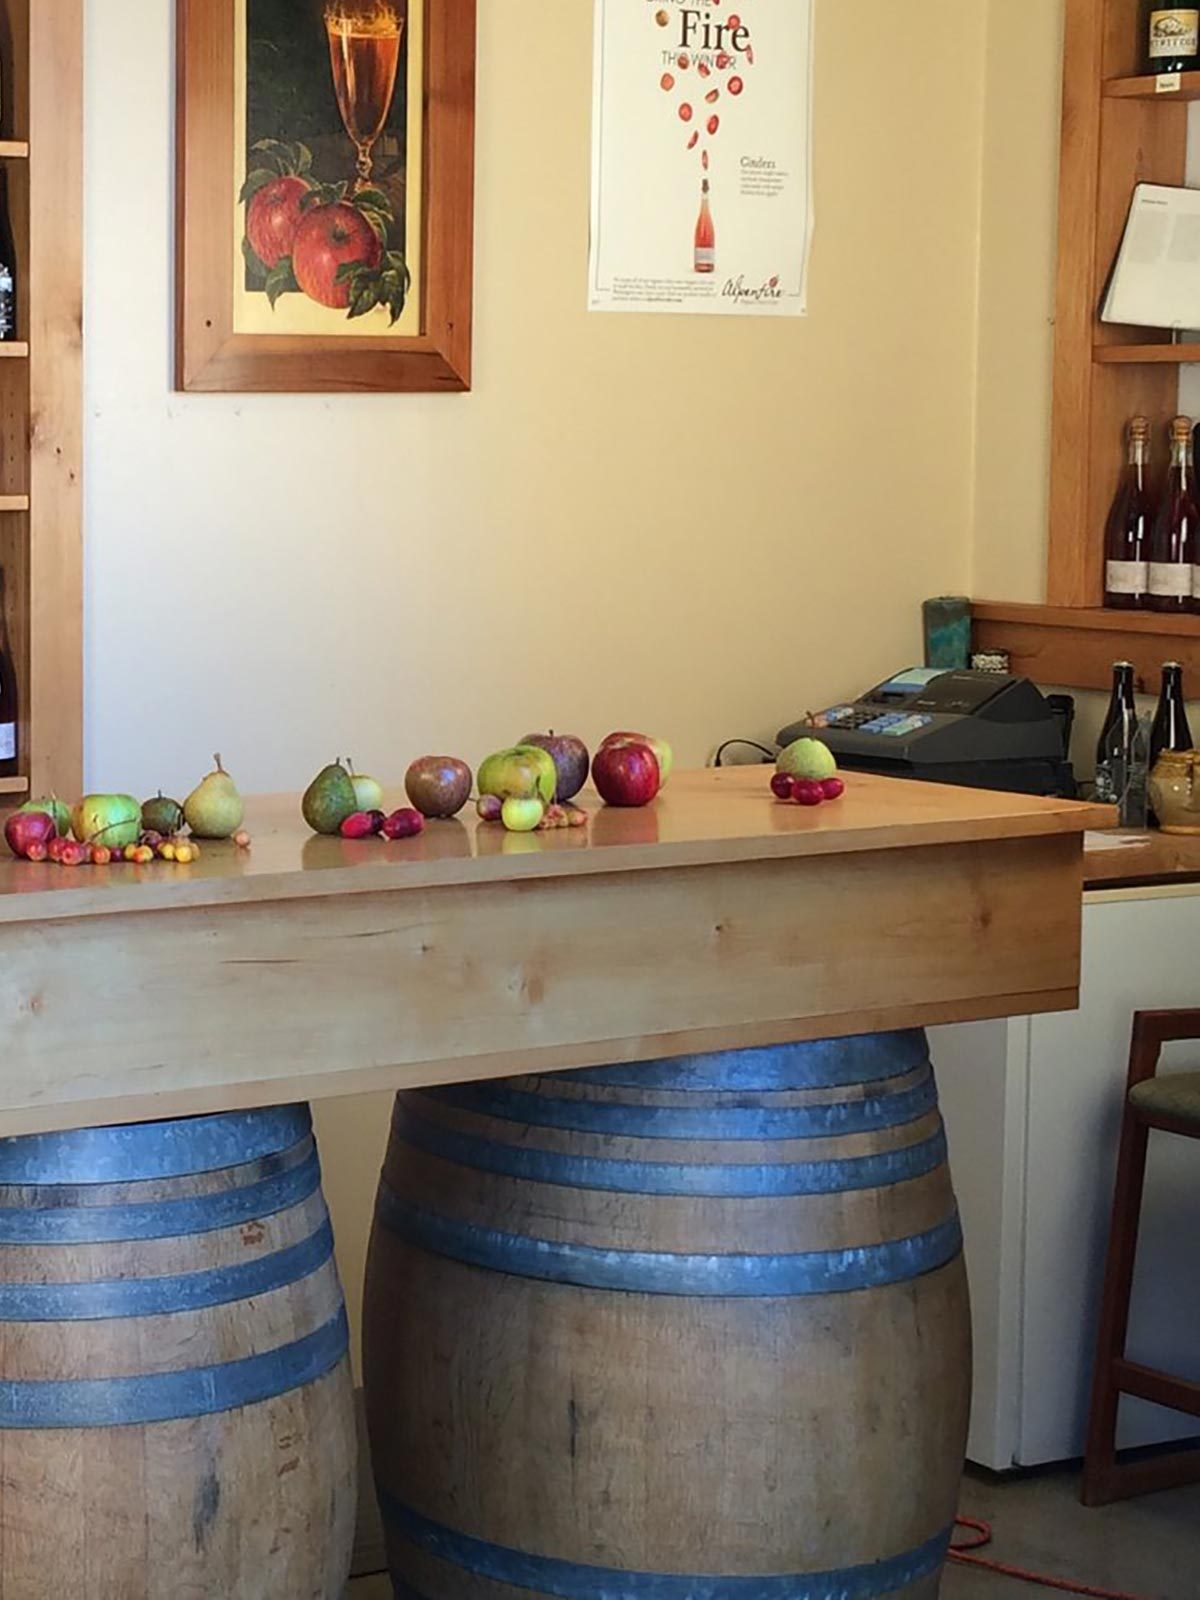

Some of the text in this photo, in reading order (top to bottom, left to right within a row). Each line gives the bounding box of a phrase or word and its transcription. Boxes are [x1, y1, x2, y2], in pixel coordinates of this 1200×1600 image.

[678, 8, 750, 52] Fire
[662, 50, 736, 70] TH WINR
